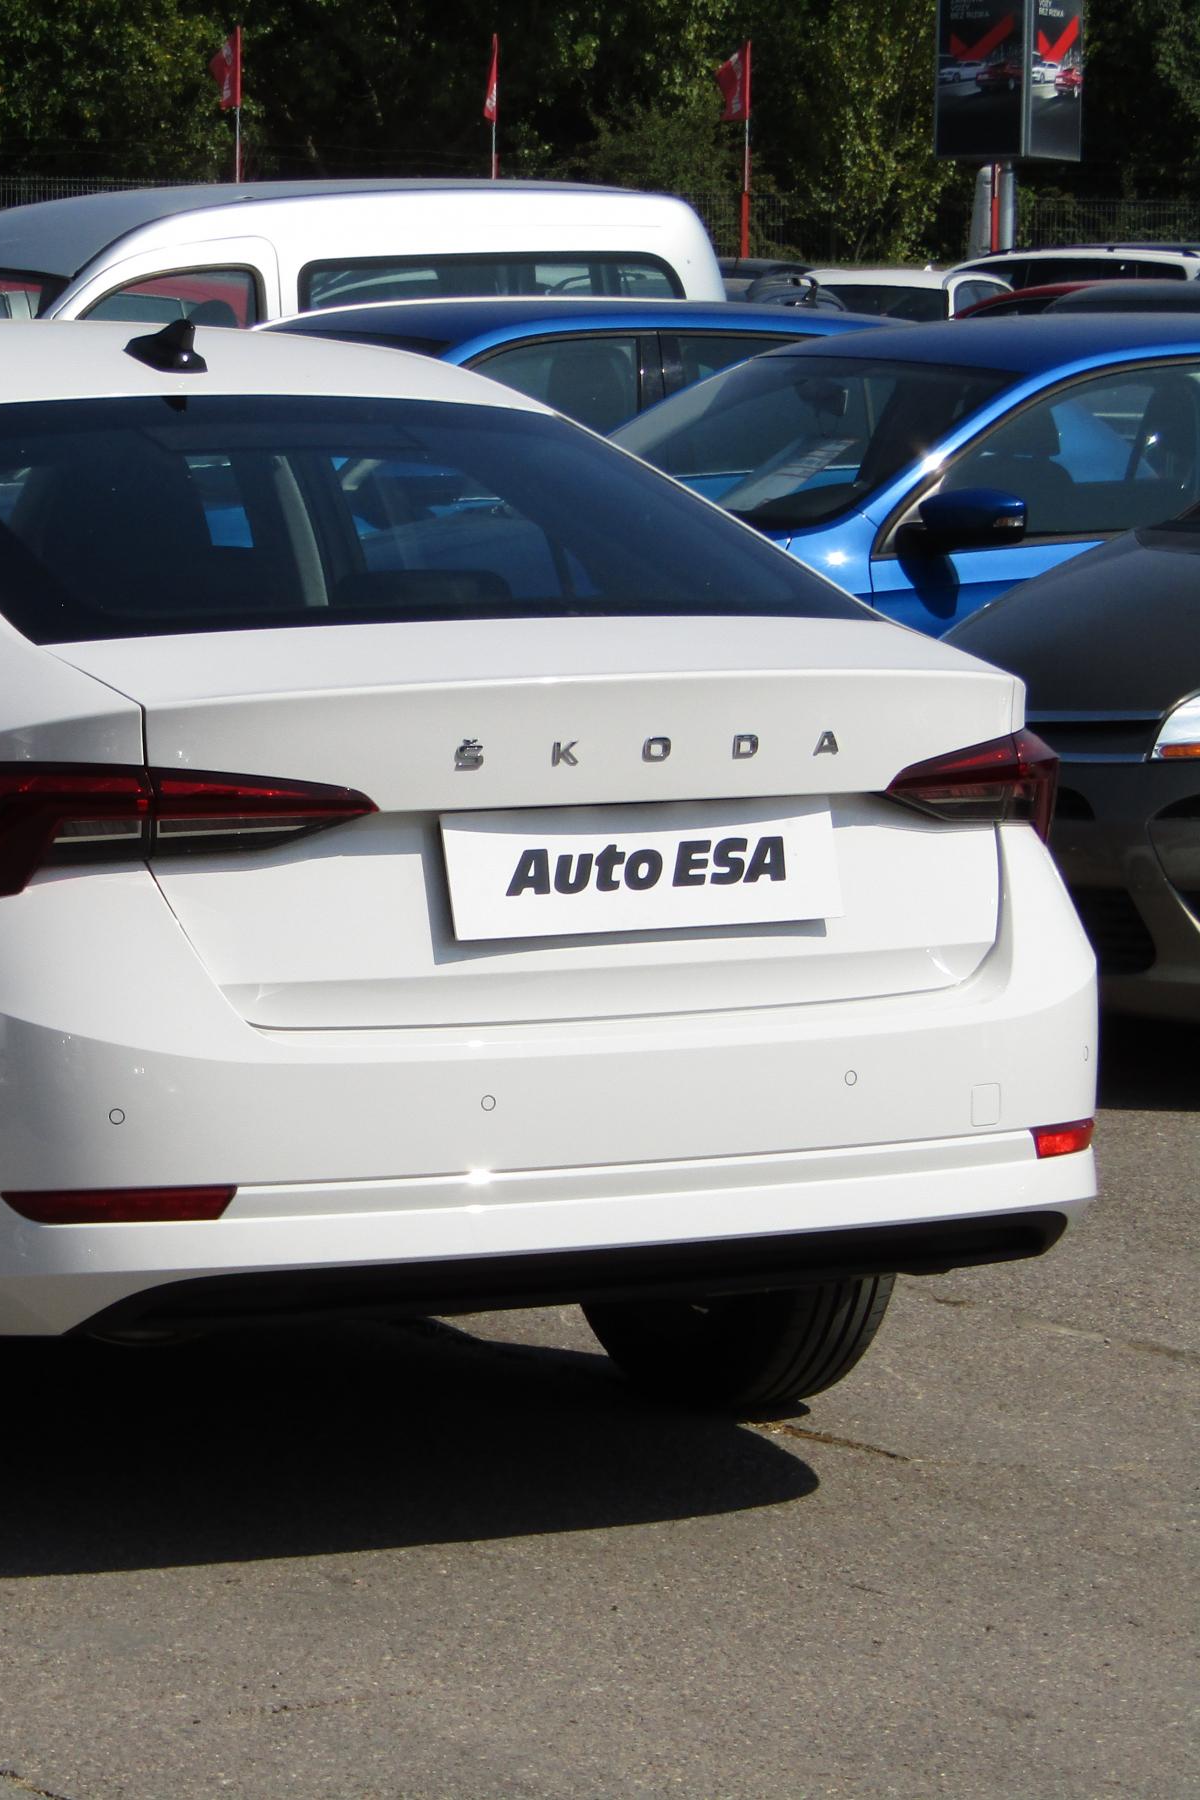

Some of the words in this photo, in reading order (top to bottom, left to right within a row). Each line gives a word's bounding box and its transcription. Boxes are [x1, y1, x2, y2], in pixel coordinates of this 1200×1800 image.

[454, 730, 840, 771] ŠKODA
[505, 844, 663, 897] Auto
[672, 836, 787, 887] ESA
